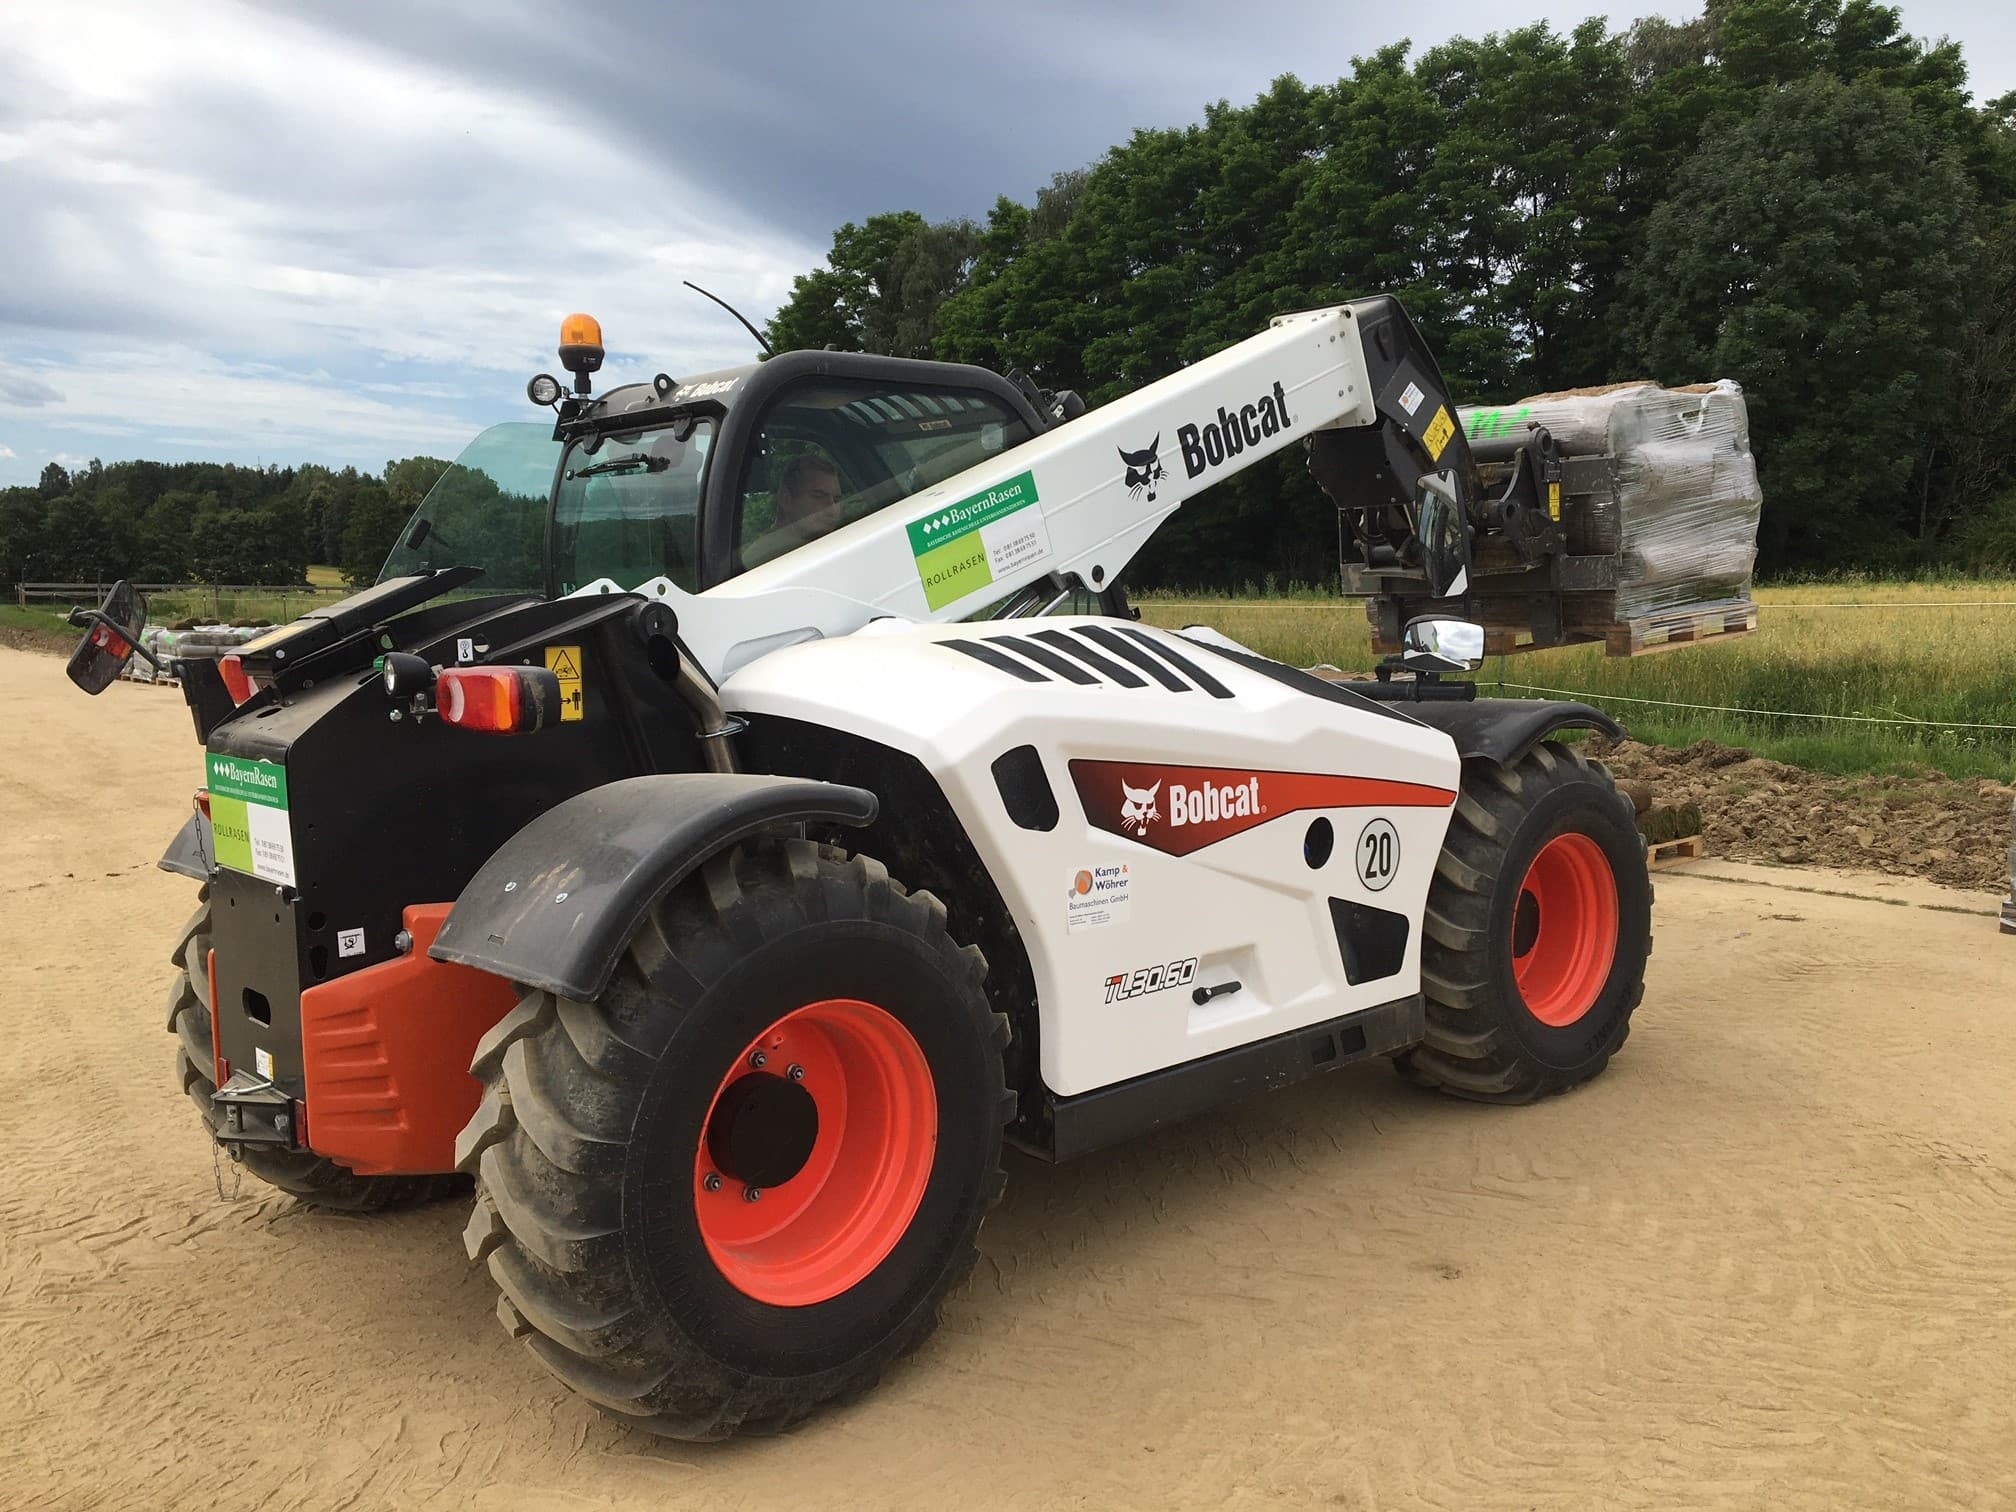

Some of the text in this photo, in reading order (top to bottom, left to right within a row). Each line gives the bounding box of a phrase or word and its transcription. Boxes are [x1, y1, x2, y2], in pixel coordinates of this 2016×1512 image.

[1177, 381, 1291, 479] Bobcat
[950, 484, 1022, 524] BayernRasen
[926, 553, 985, 587] ROLLRASEN
[230, 762, 278, 789] BayernRasen
[1169, 776, 1260, 827] Bobcat
[213, 823, 250, 842] ROLLRASEN
[1095, 864, 1129, 878] Kamp &
[1365, 832, 1392, 879] 20
[1069, 893, 1129, 911] Baumaschinen GmbH
[1095, 880, 1129, 891] Wöhrer
[1104, 957, 1198, 1005] TL30.60
